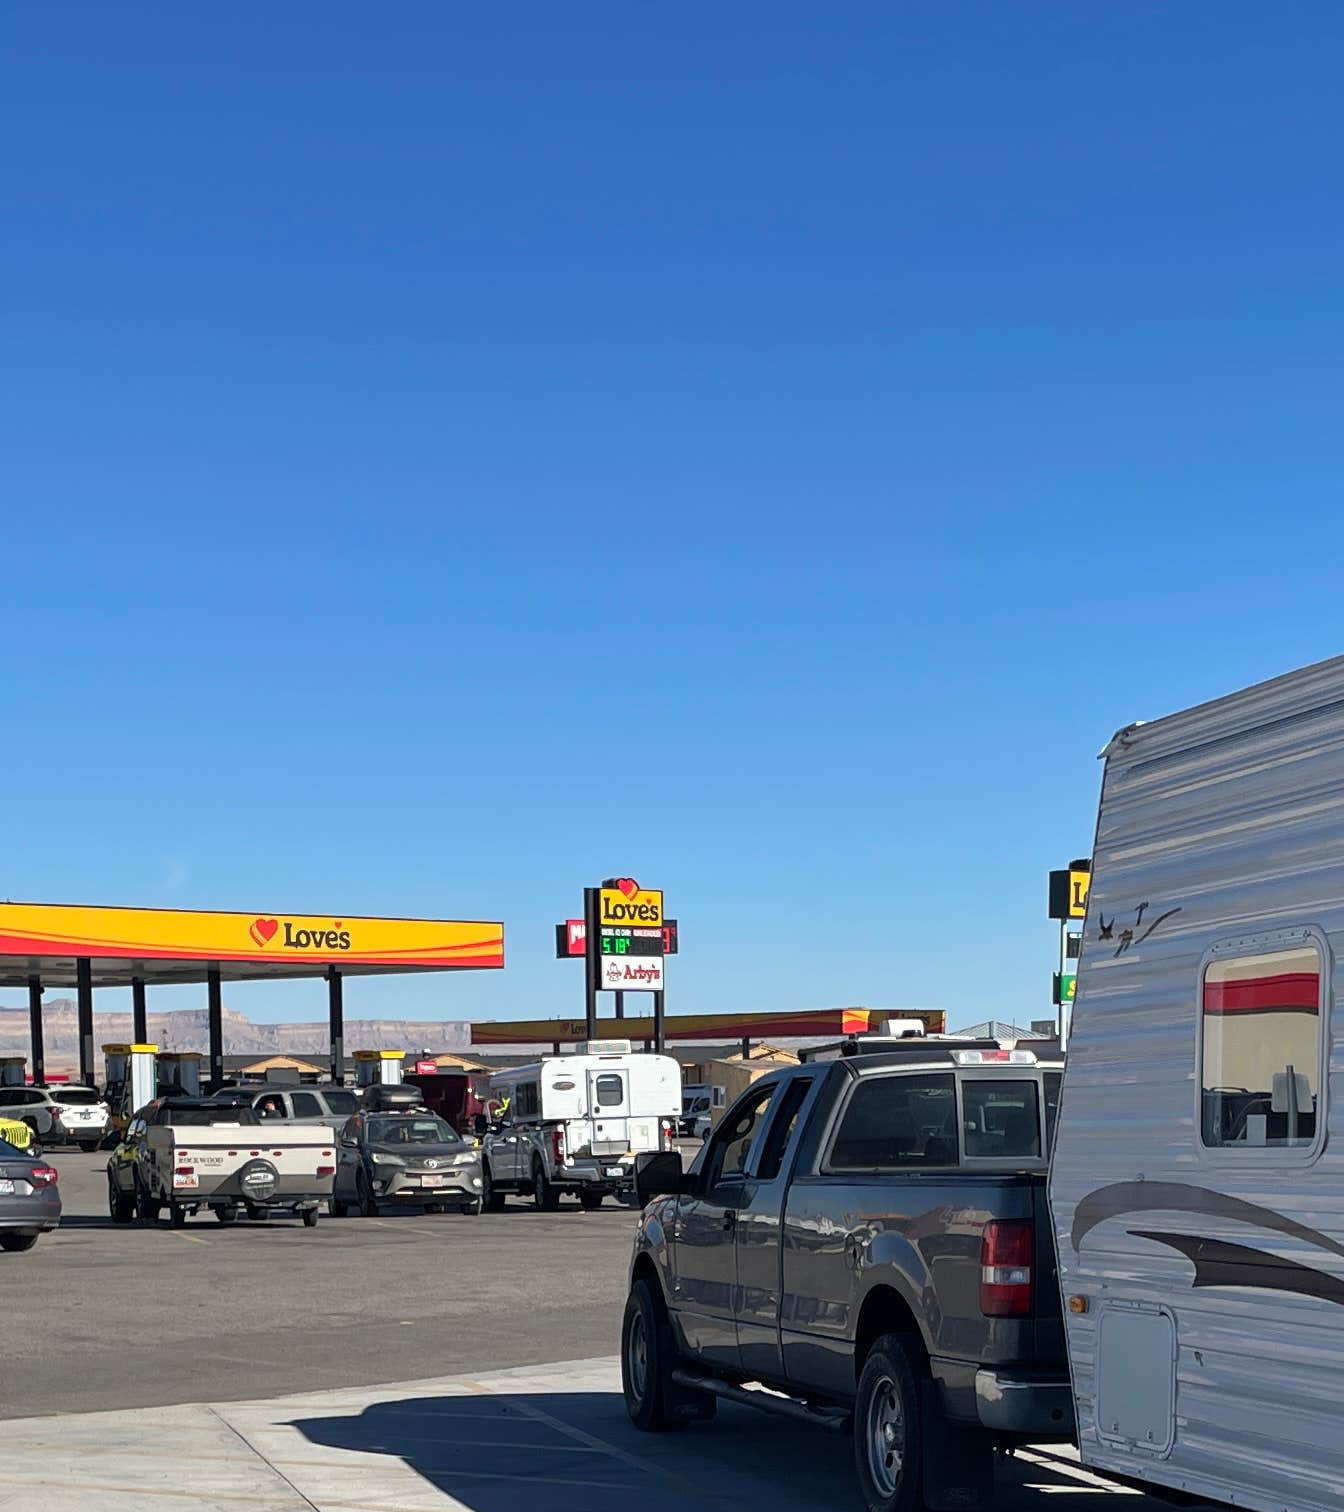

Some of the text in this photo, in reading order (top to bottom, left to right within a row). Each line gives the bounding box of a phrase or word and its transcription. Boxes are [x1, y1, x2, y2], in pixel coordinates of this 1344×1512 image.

[603, 897, 660, 922] Love's
[283, 921, 351, 950] Love's
[623, 963, 661, 984] Arby's
